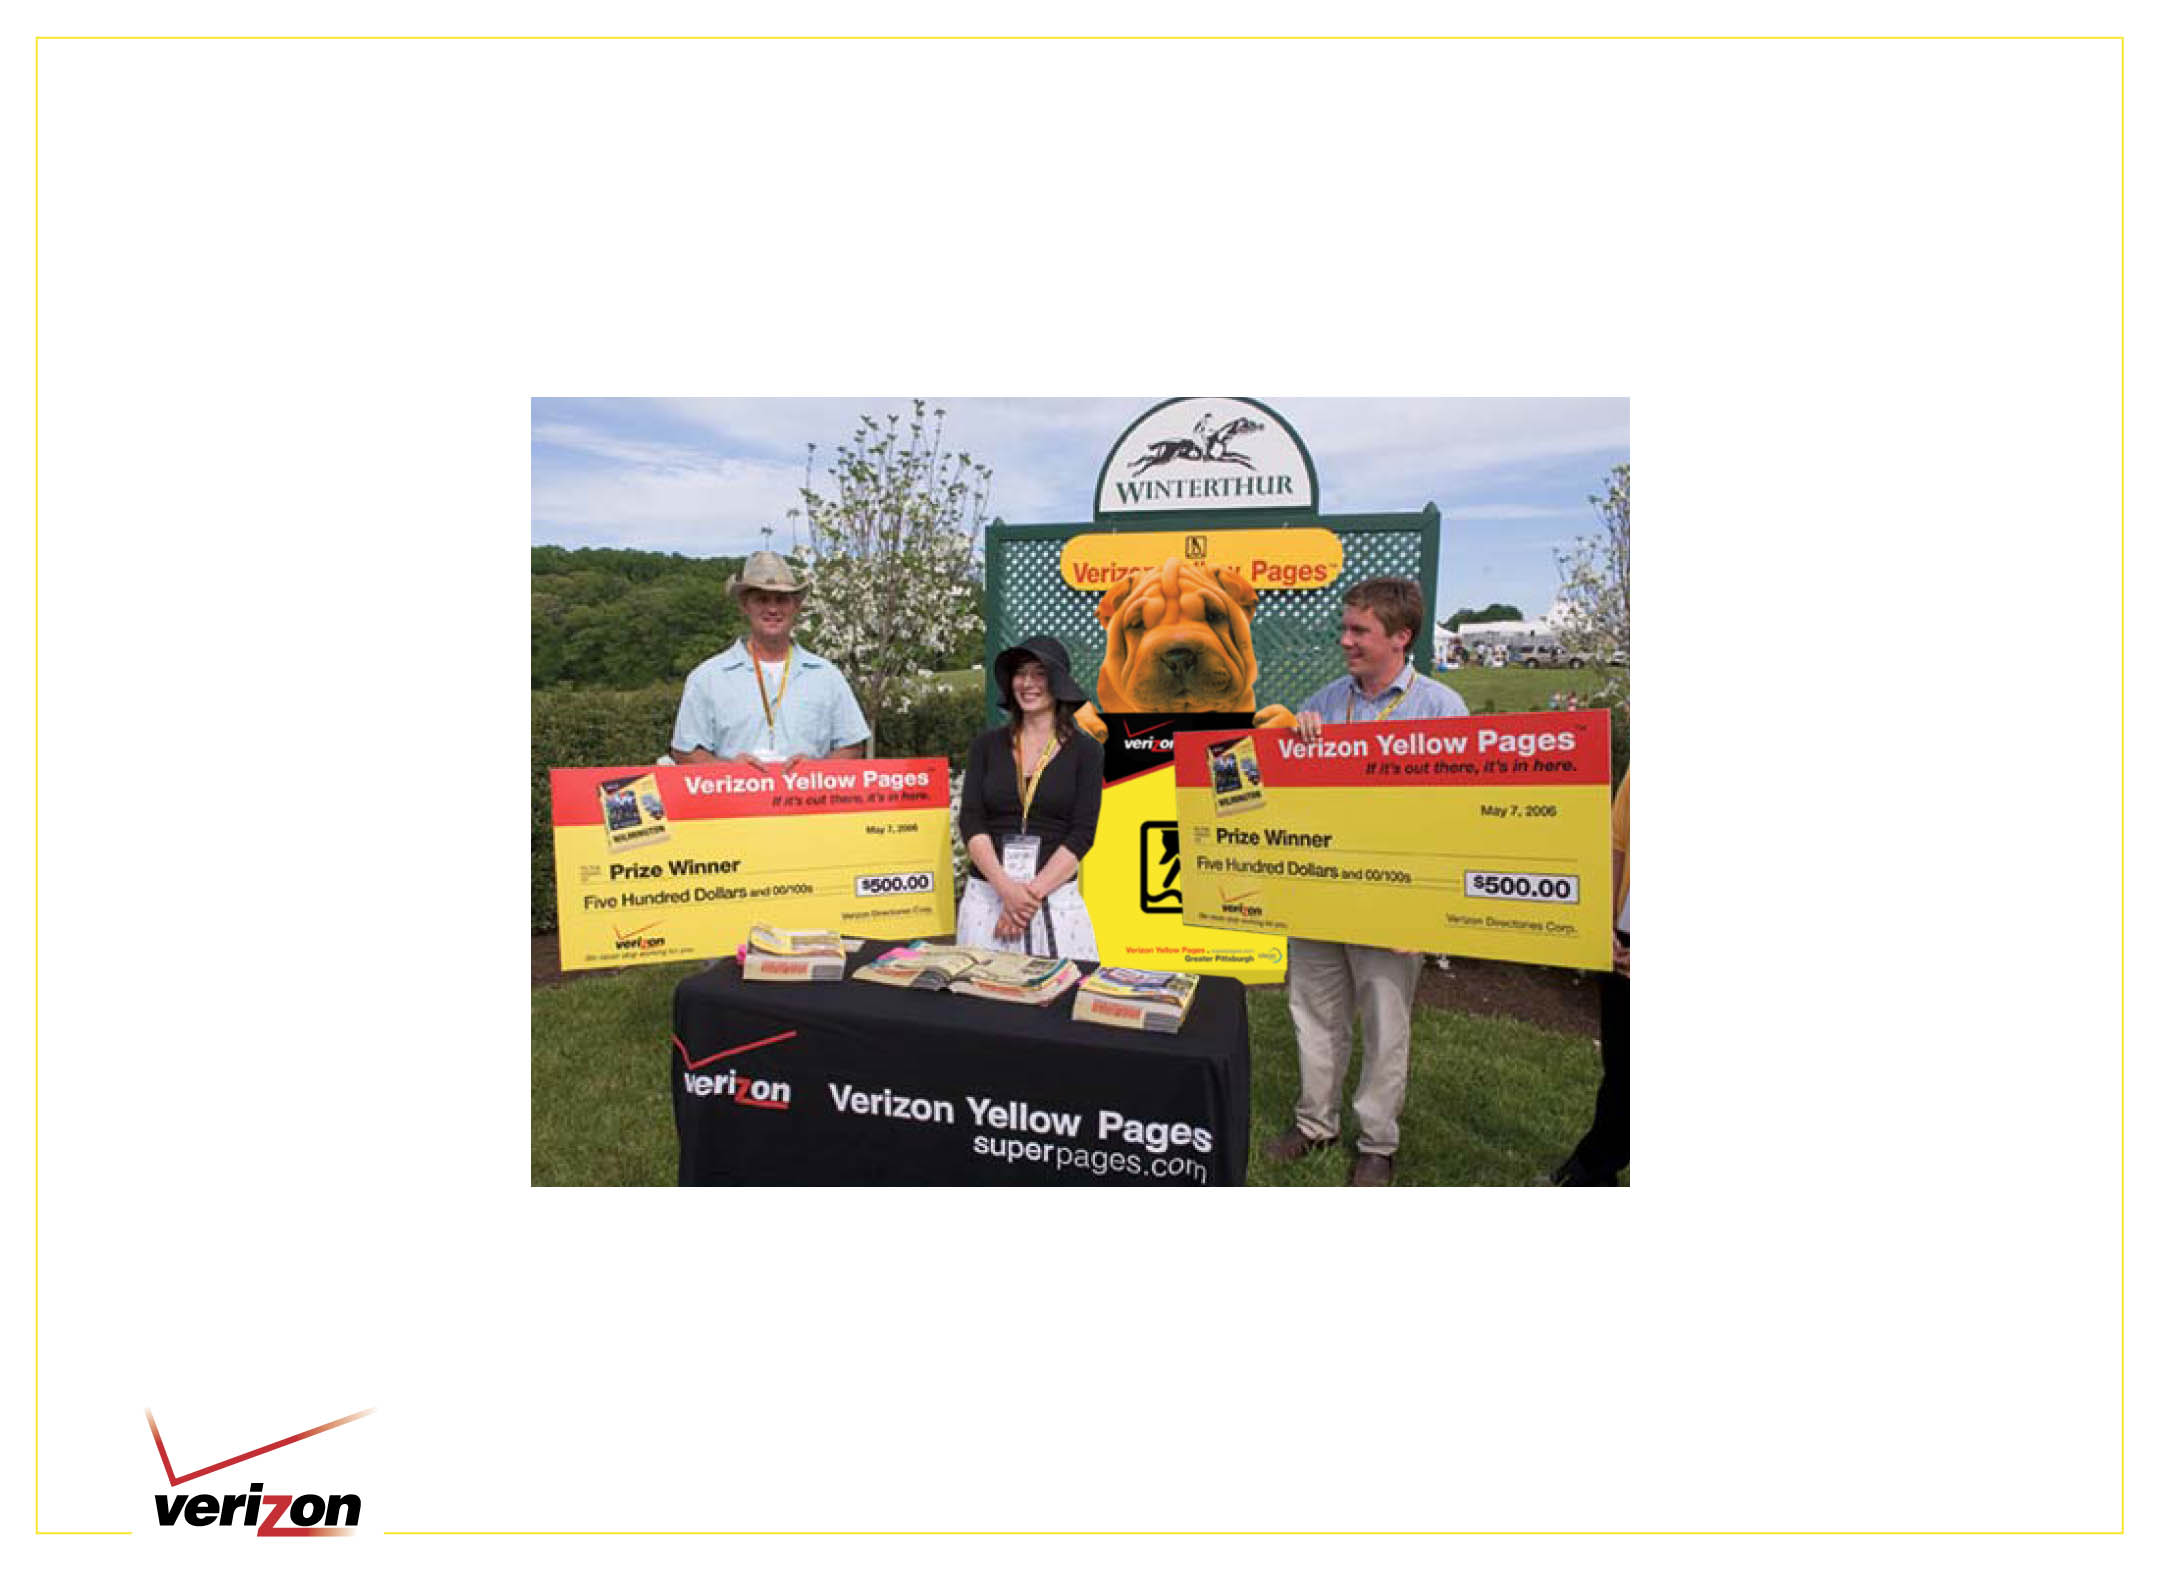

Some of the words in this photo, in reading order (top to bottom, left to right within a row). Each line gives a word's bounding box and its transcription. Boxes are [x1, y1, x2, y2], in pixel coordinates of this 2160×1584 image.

[1116, 474, 1293, 504] WINTERTHUR
[1073, 563, 1156, 584] Veriz
[1251, 560, 1328, 586] Pages
[1278, 738, 1368, 759] Verizon
[1376, 732, 1468, 756] Yellow
[1478, 729, 1576, 757] Pages
[1366, 762, 1377, 775] If
[1379, 763, 1400, 775] it's
[1404, 764, 1429, 775] out
[1433, 761, 1479, 775] there,
[1483, 761, 1507, 773] it's
[1512, 760, 1527, 773] in
[1533, 760, 1577, 773] here.
[684, 775, 775, 795] Verizon
[782, 772, 856, 791] Yellow
[863, 770, 929, 790] Pages
[1481, 805, 1506, 818] May
[1526, 805, 1556, 817] 2006
[866, 825, 885, 834] May
[1216, 828, 1260, 846] Prize
[1264, 829, 1333, 848] Winner
[610, 863, 663, 880] Prize
[669, 859, 741, 876] Winner
[1196, 855, 1223, 871] Five
[1226, 857, 1284, 875] Hundred
[1287, 861, 1339, 879] Dollars
[1342, 869, 1362, 881] and
[861, 875, 929, 893] $500.00
[1473, 874, 1571, 899] $500.00
[584, 895, 617, 910] Five
[622, 888, 690, 907] Hundred
[694, 886, 747, 902] Dollars
[750, 886, 770, 897] and
[1446, 912, 1483, 925] Verizon
[616, 936, 665, 950] verizon
[1182, 947, 1205, 955] Pages
[1215, 955, 1255, 964] Pittsburgh
[684, 1069, 791, 1109] verizon
[829, 1082, 955, 1124] Verizon
[965, 1096, 1082, 1137] Yellow
[1099, 1110, 1213, 1153] Pages
[973, 1135, 1208, 1185] superpages.com
